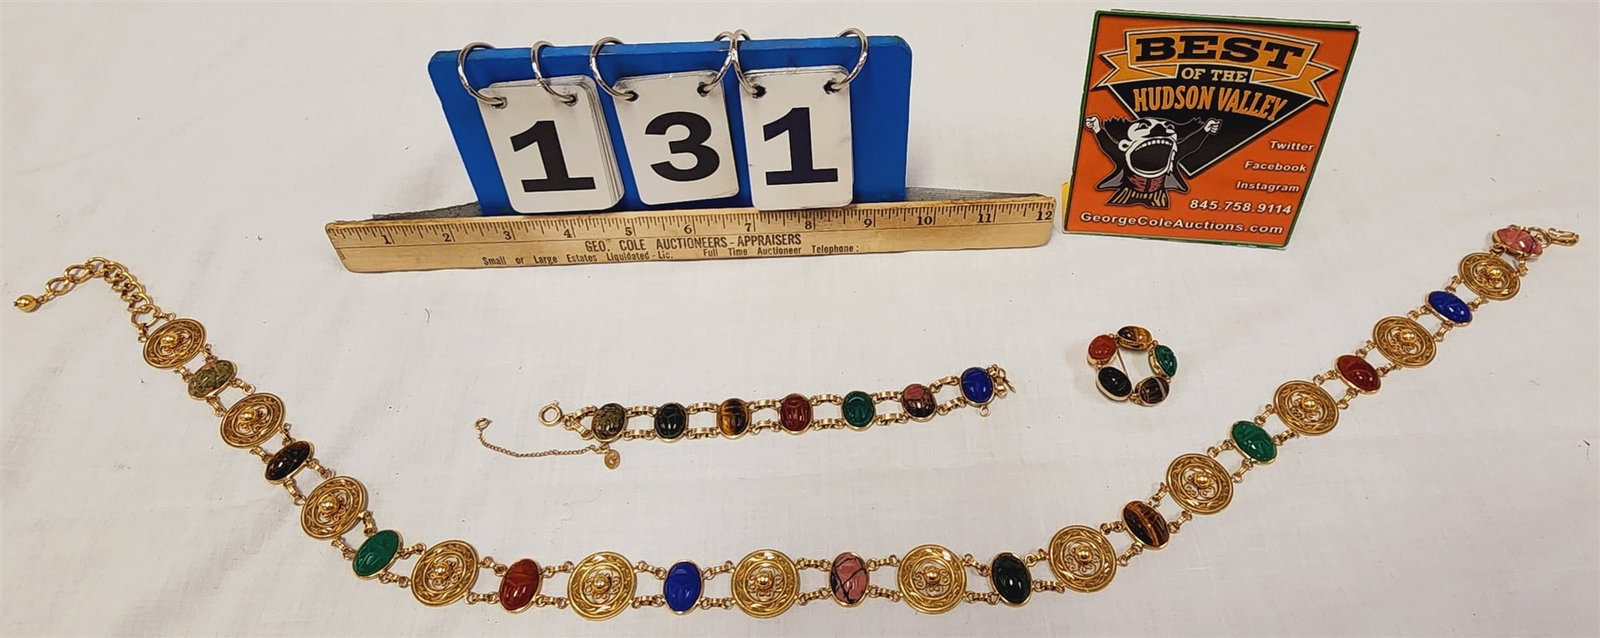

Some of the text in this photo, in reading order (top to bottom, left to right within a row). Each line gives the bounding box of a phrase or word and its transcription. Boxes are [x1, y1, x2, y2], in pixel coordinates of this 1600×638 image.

[1135, 34, 1305, 70] BEST
[1181, 68, 1249, 84] OF THE
[1133, 85, 1288, 122] HUDSON VALLEY
[510, 106, 838, 193] 1 3 1
[1269, 140, 1315, 152] Twitter
[1244, 160, 1307, 173] Facebook
[1236, 180, 1300, 193] Instagram
[1189, 199, 1292, 215] 845.758.9114
[381, 210, 1053, 245] 1 2 3 4 5 6 7 8 9 10 11 12
[1080, 212, 1284, 234] GeorgeColeAuctions.com
[585, 240, 611, 252] GEO.
[619, 239, 647, 251] COLE
[656, 236, 728, 250] AUCTIONEERS
[737, 233, 801, 247] APPRAISERS
[482, 256, 507, 266] Small
[515, 256, 524, 264] or
[533, 254, 558, 266] Large
[566, 253, 598, 263] Estates
[606, 251, 650, 263] Liquidated
[658, 250, 674, 259] Lic.
[703, 248, 718, 257] Full
[727, 247, 748, 256] Time
[757, 246, 801, 255] Auctioneer
